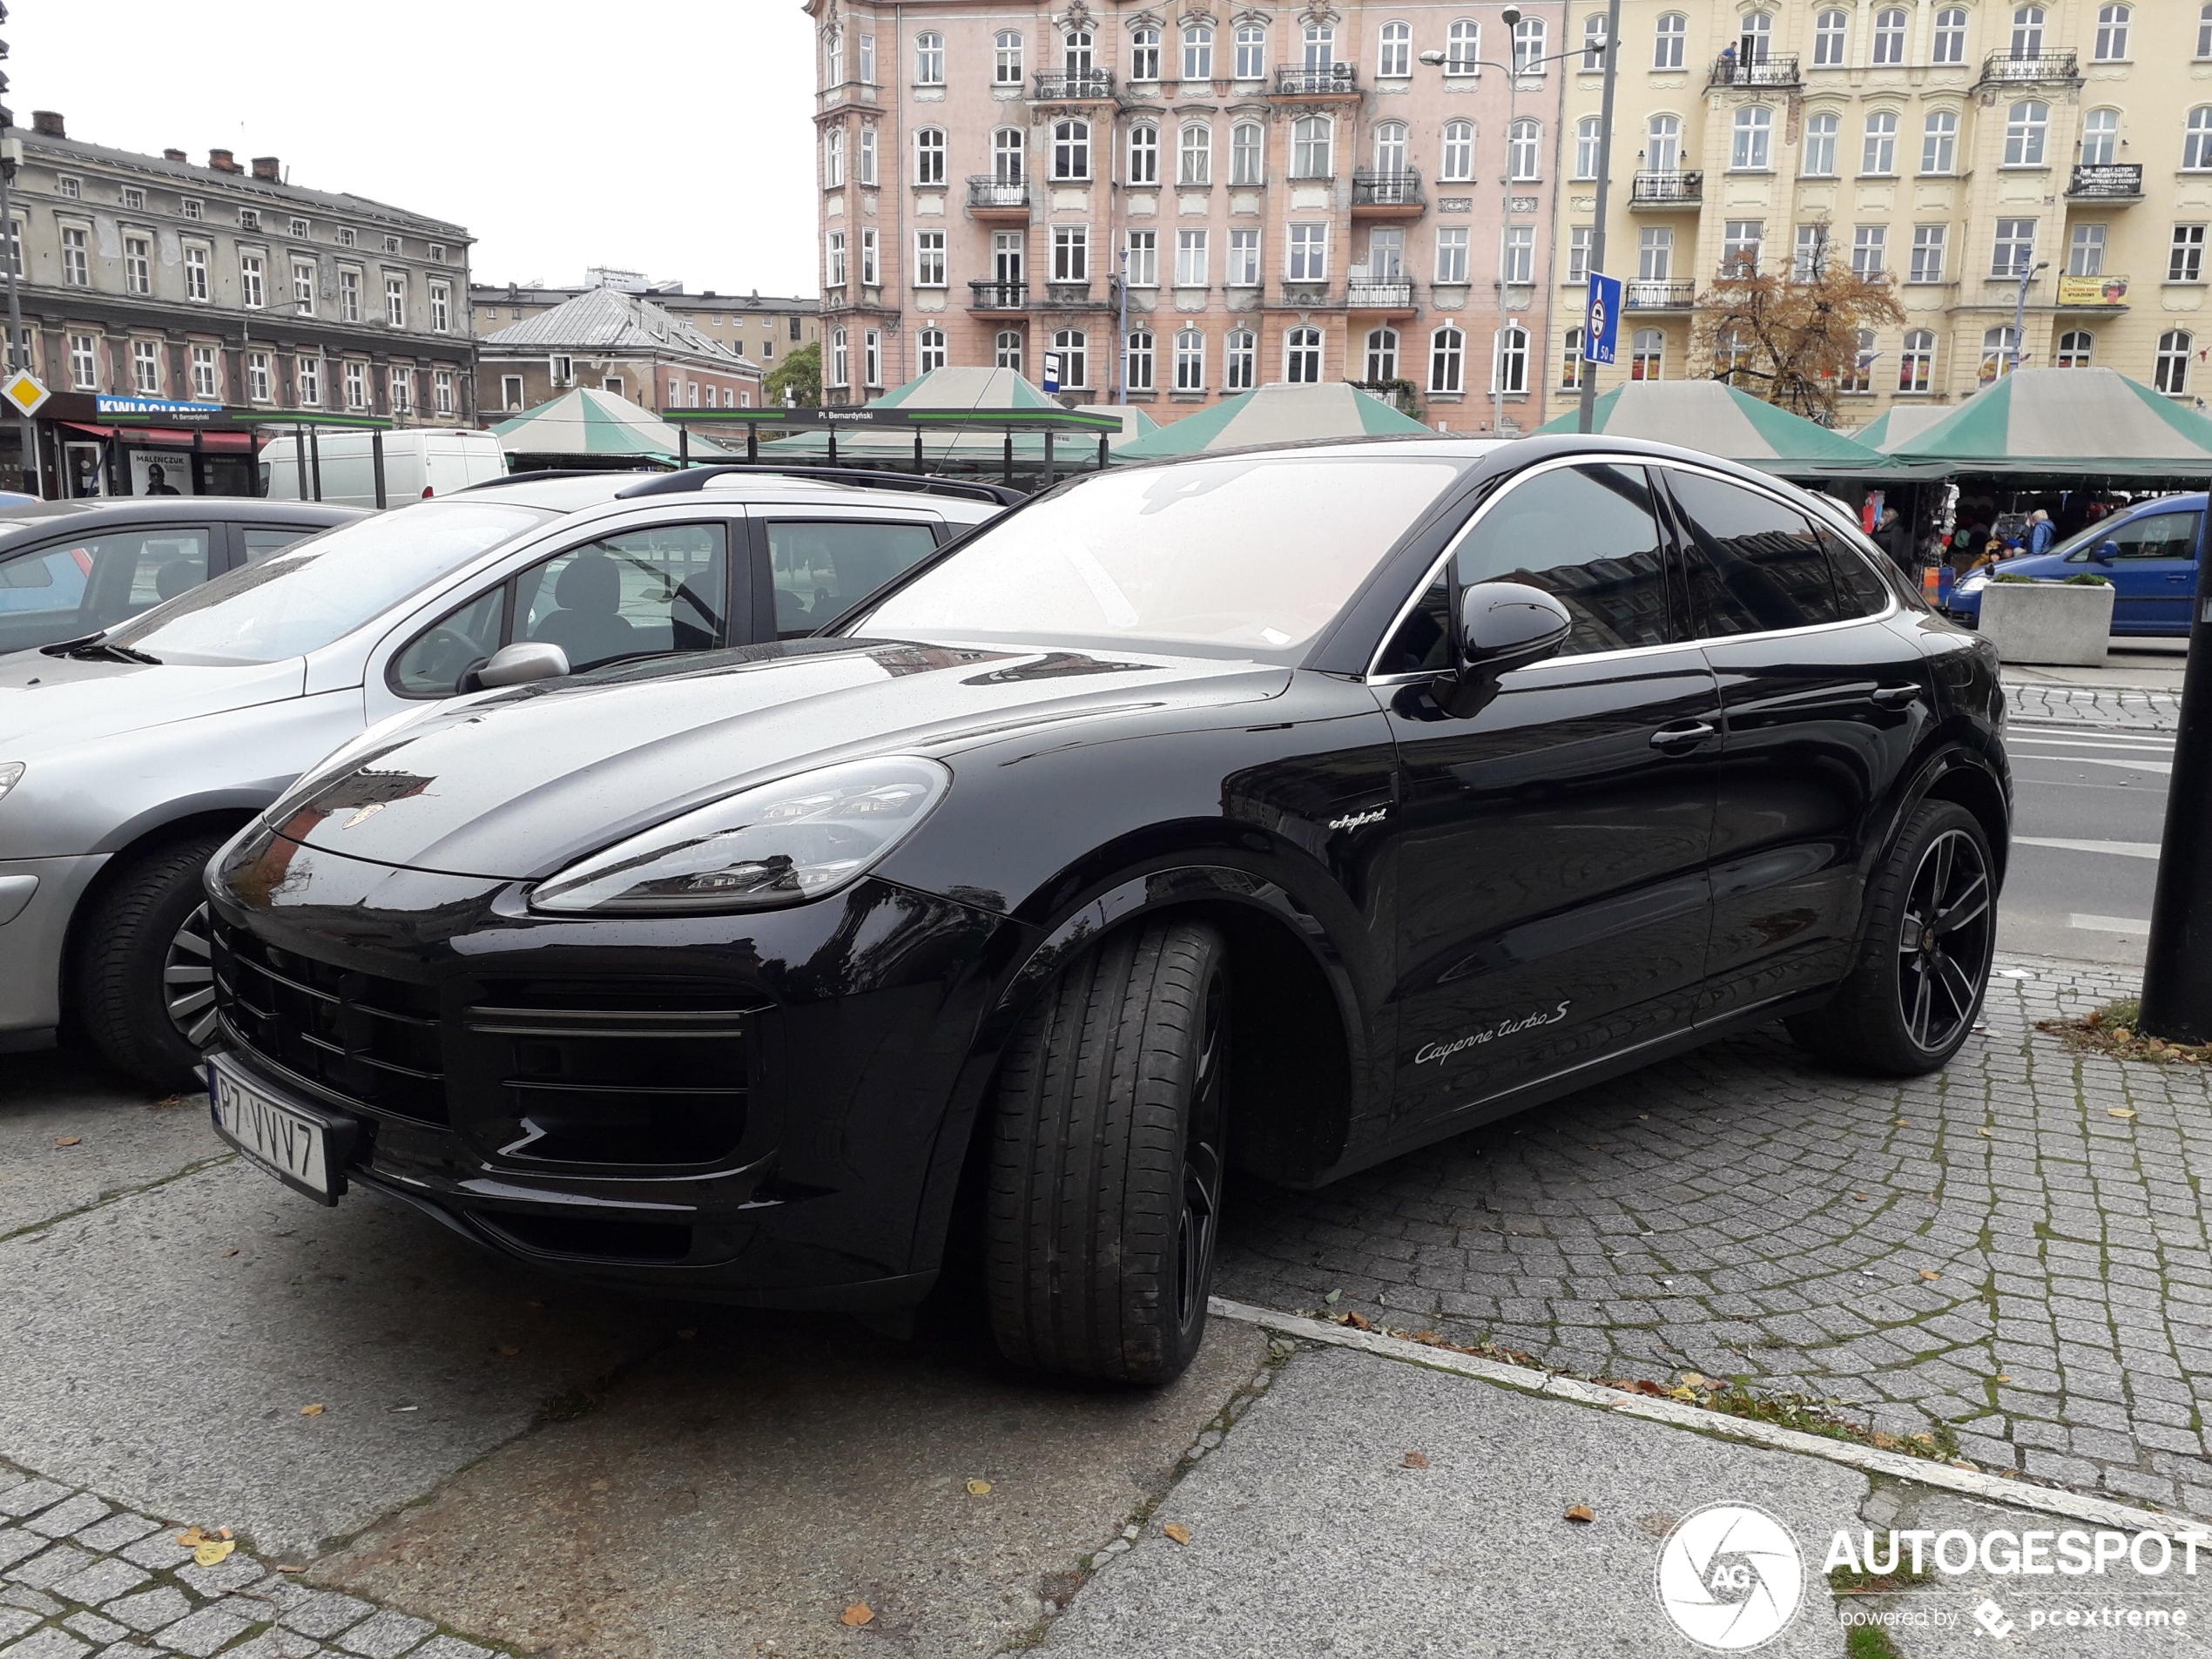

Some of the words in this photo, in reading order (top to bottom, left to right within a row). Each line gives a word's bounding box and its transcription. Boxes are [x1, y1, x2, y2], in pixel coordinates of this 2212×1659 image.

[1600, 345, 1609, 361] 50
[828, 411, 873, 421] Bernardyński
[136, 455, 185, 464] MALEŃCZUK
[1414, 1029, 1494, 1066] Cayenne
[1546, 1001, 1571, 1023] S
[219, 1076, 239, 1135] P7
